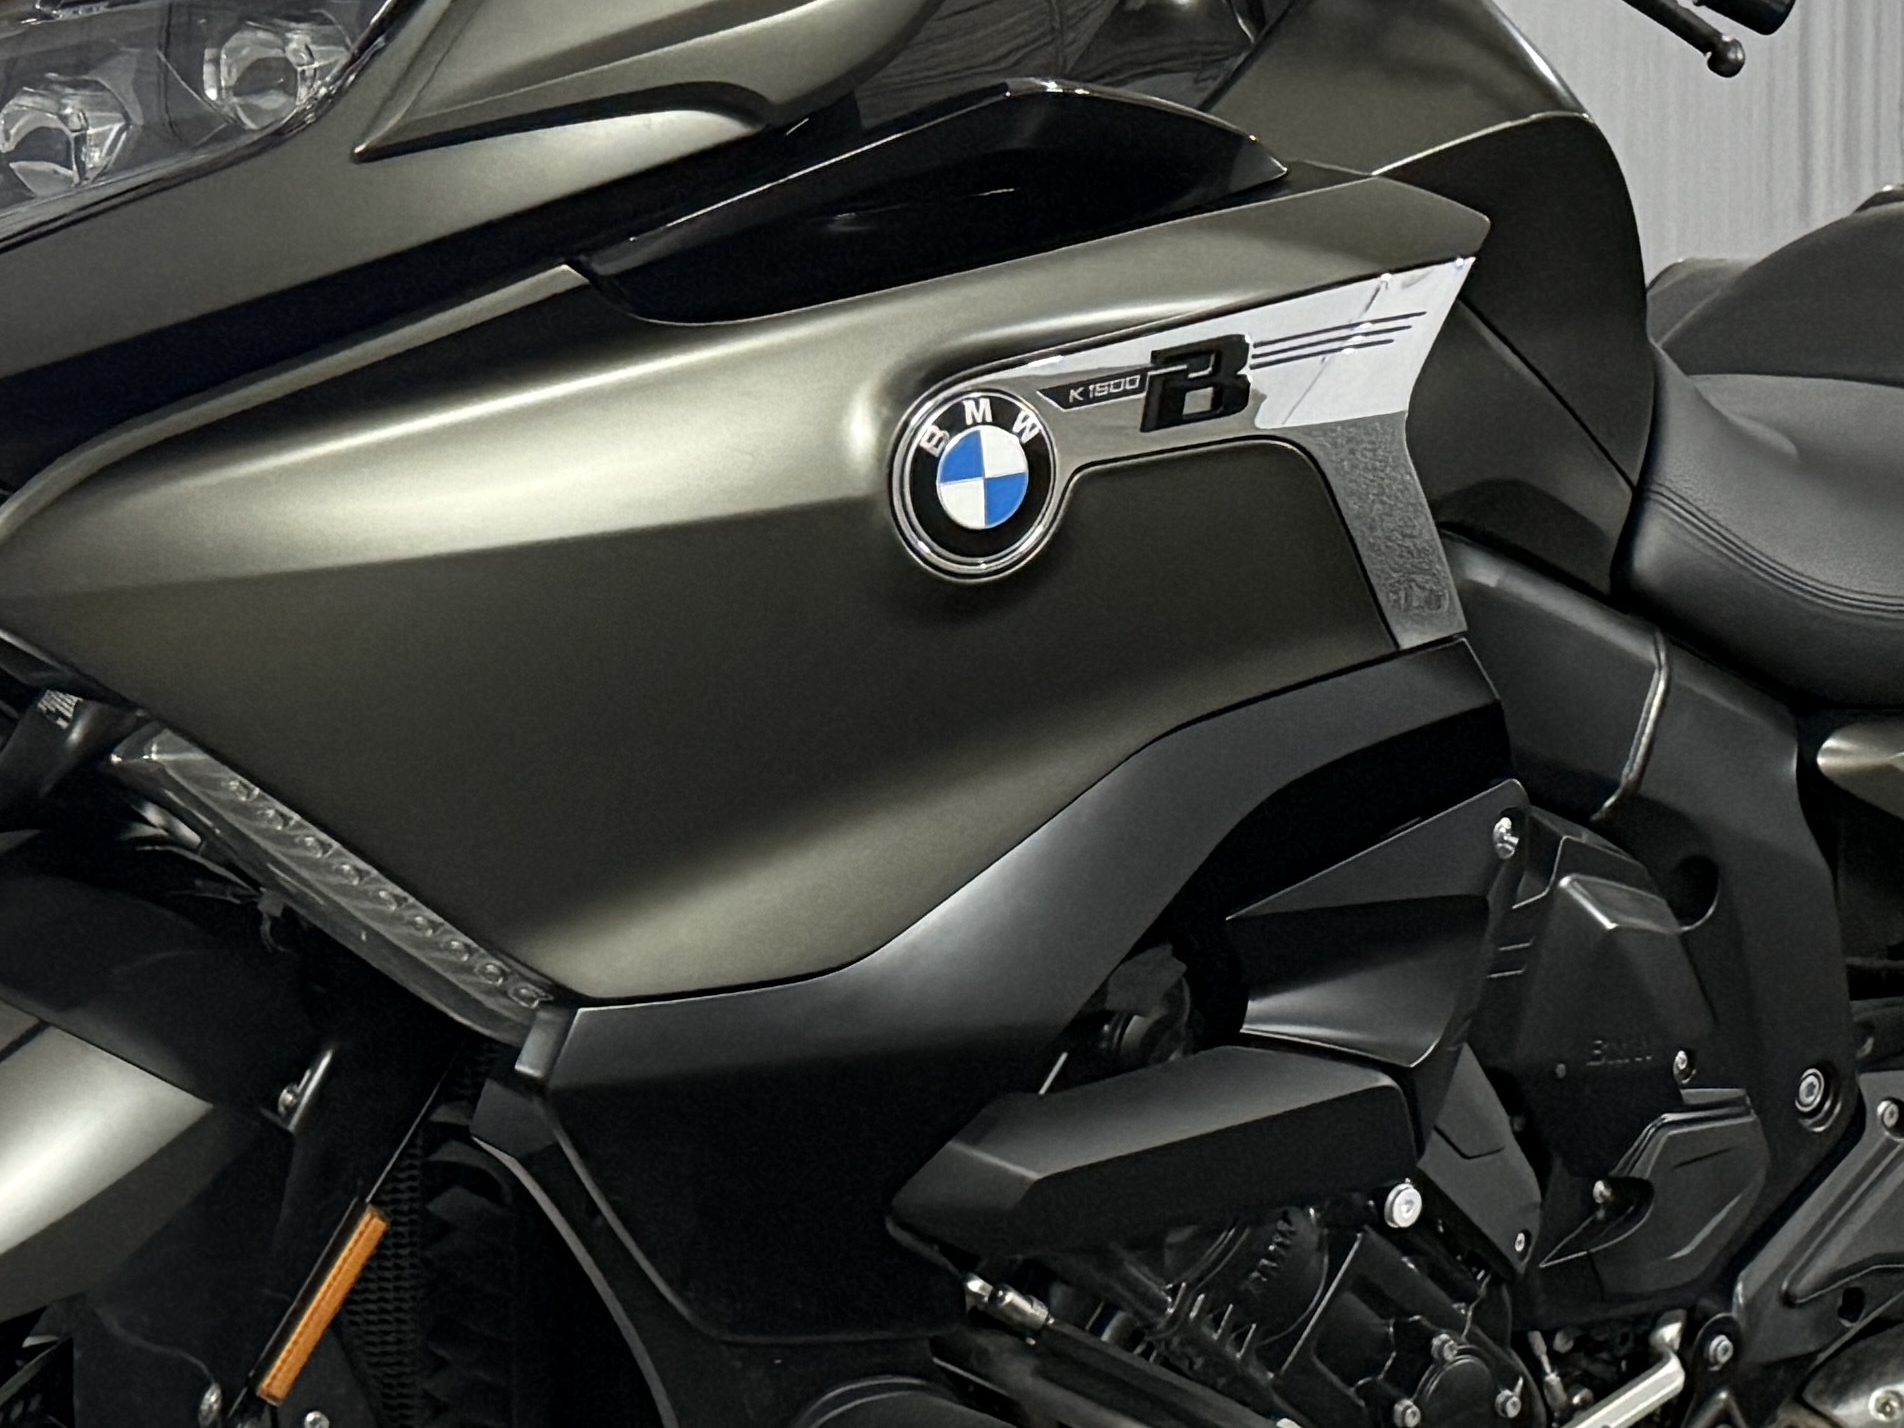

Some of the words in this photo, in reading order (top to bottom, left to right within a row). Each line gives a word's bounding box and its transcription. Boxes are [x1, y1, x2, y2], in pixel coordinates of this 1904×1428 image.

[1068, 387, 1085, 404] K
[1088, 374, 1142, 400] 1600
[1139, 333, 1252, 433] B
[918, 397, 1042, 459] BMW
